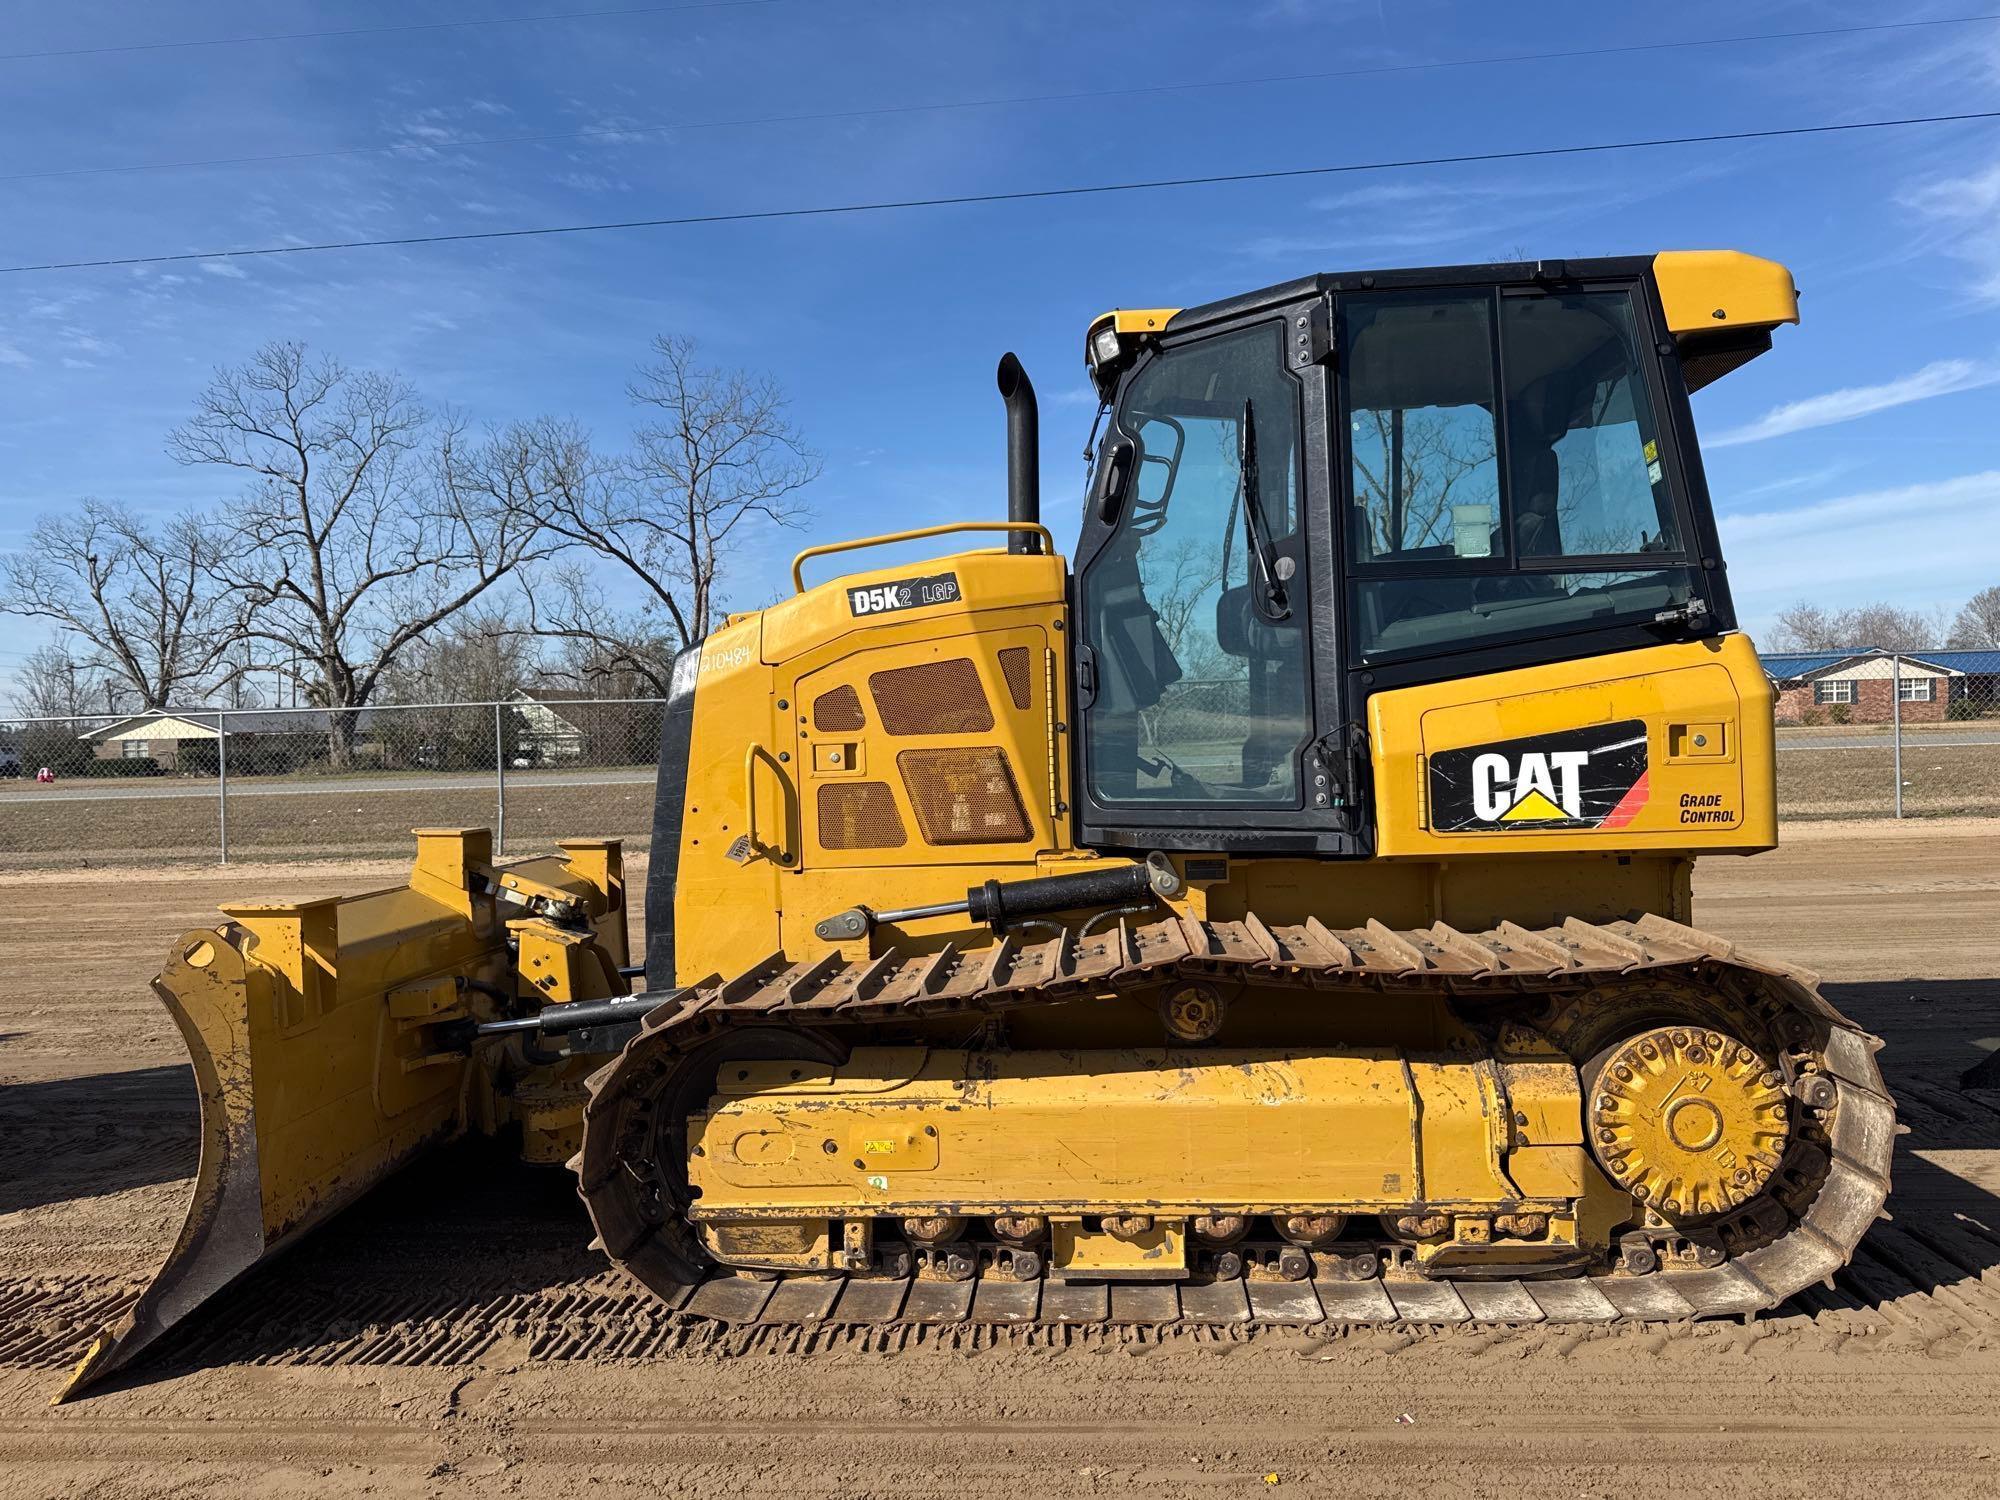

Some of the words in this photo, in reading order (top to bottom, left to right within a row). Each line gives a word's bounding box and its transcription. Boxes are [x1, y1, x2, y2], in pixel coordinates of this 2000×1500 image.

[854, 585, 912, 614] D5K2
[922, 582, 956, 603] LGP
[700, 645, 750, 672] 210484
[1472, 750, 1589, 821] CAT
